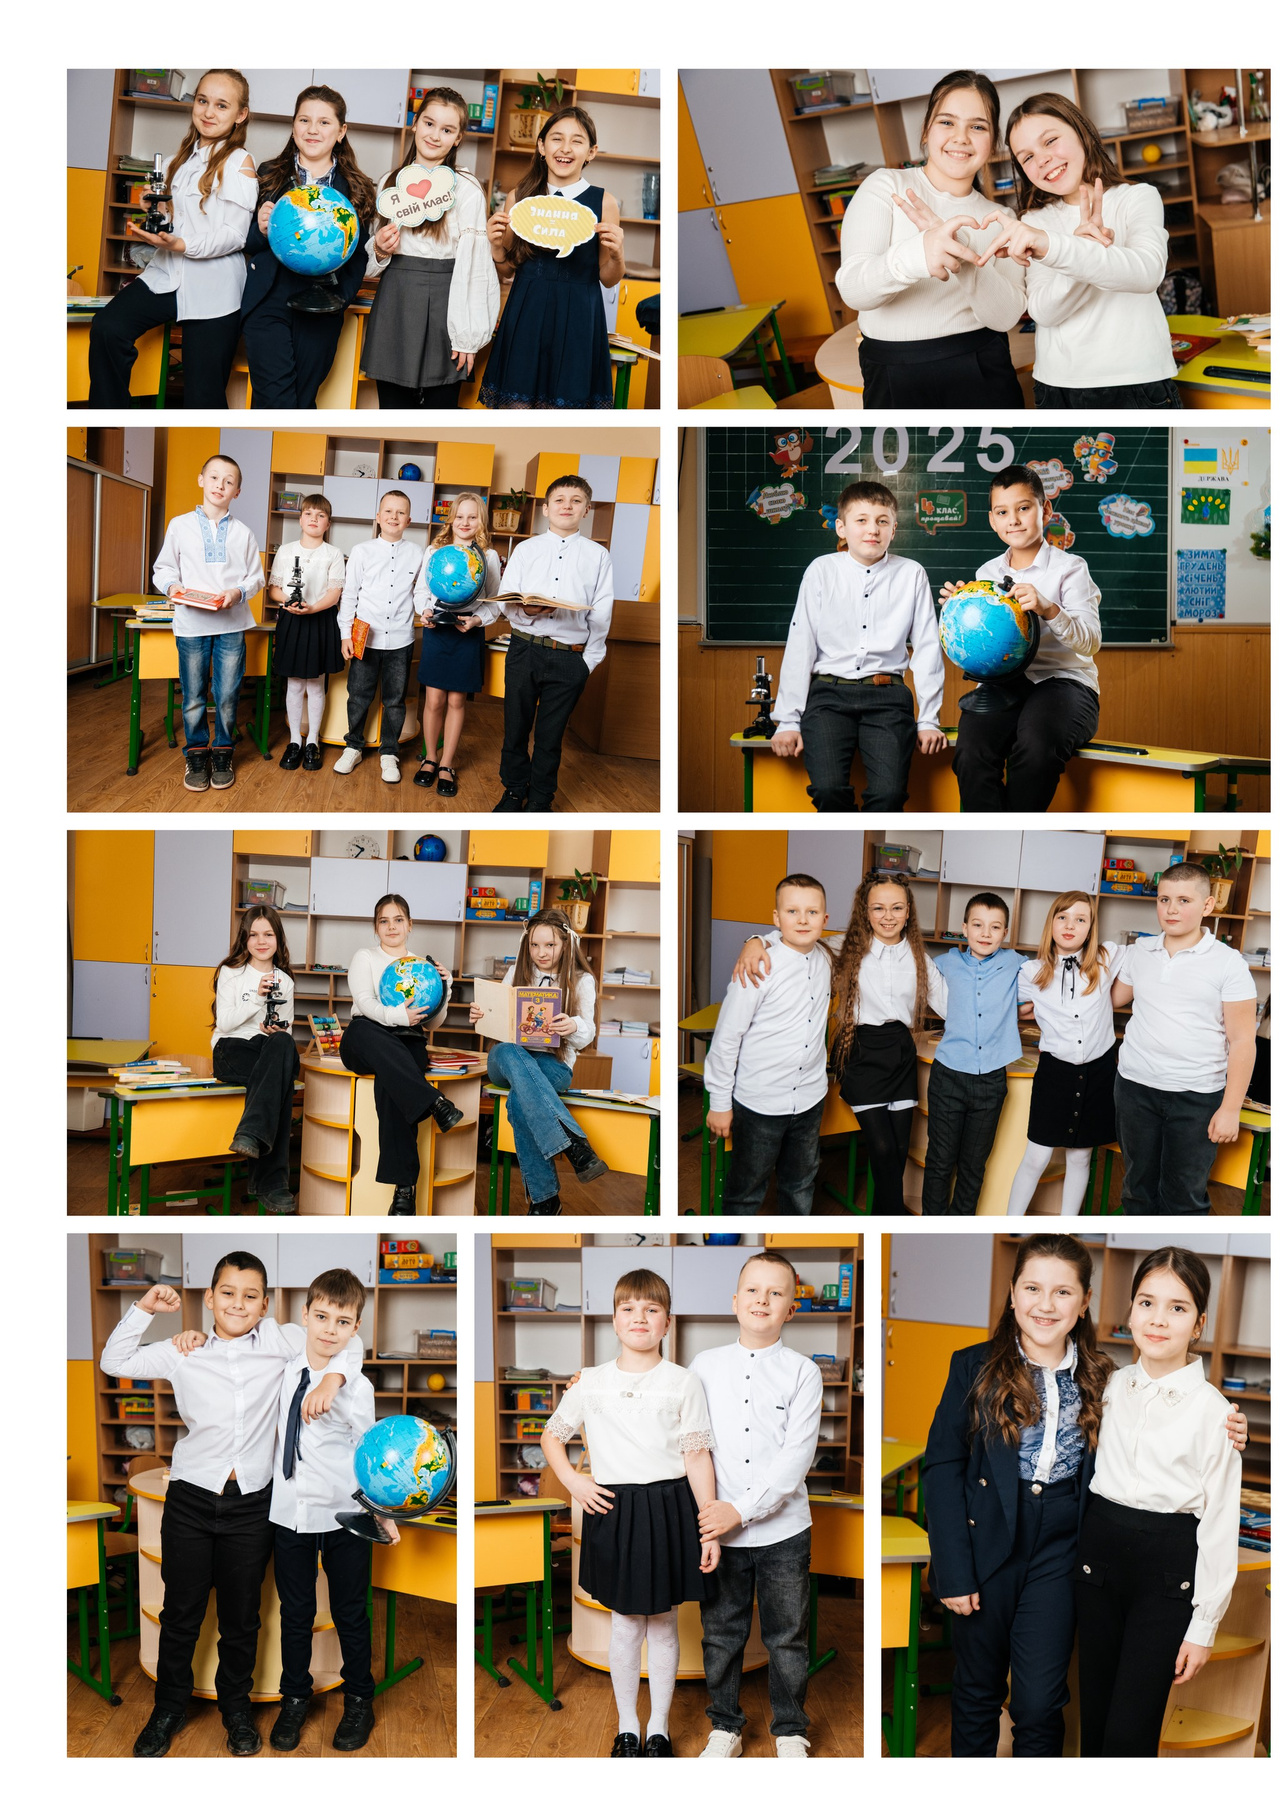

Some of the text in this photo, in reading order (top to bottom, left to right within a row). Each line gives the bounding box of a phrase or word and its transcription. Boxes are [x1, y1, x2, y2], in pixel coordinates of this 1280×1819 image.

[390, 193, 401, 205] Я
[396, 191, 452, 218] свій клас!
[921, 497, 960, 515] 4 КЛАС,
[920, 514, 962, 523] прощавай!
[1187, 550, 1216, 559] ЗИМА
[1179, 561, 1224, 571] ГРУДЕНЬ
[1184, 608, 1217, 618] МОРОЗ
[518, 991, 560, 999] МАТЕМАТИКА
